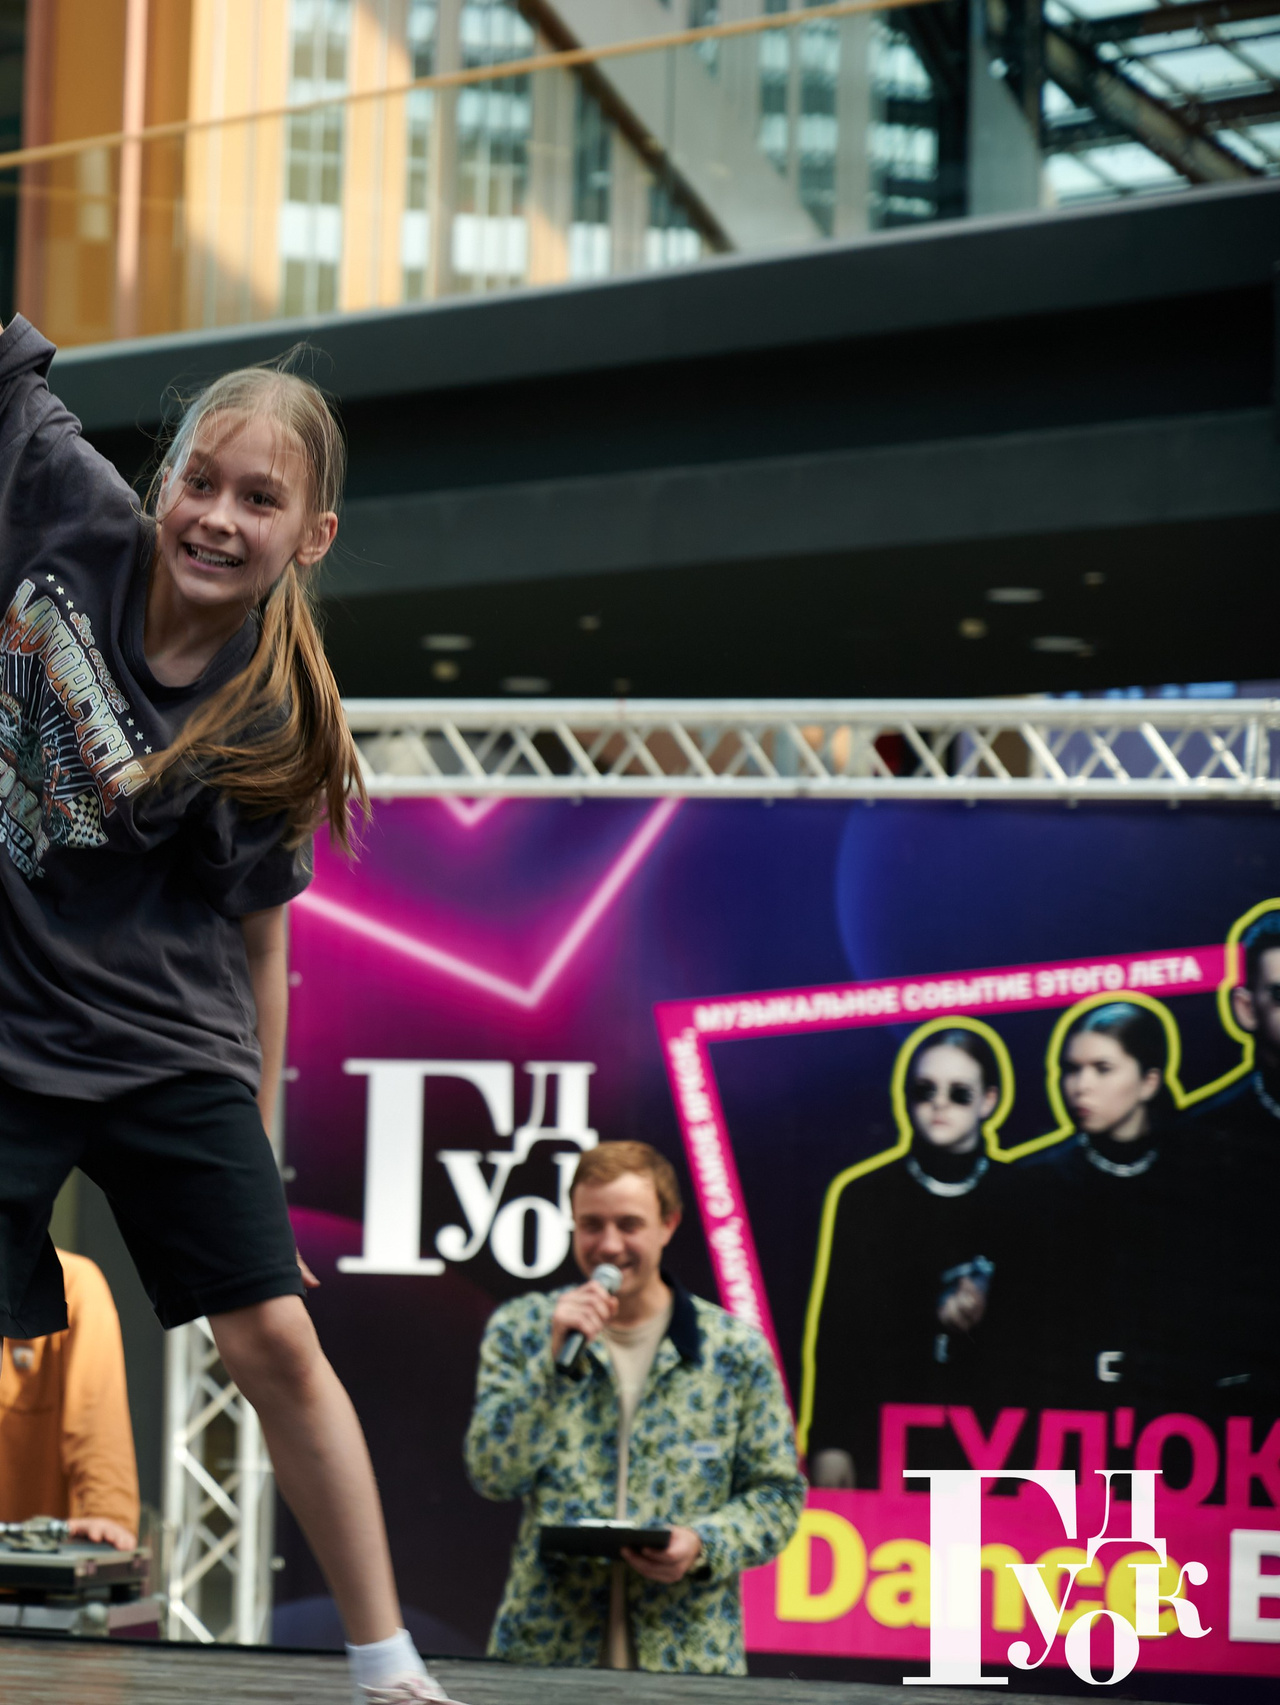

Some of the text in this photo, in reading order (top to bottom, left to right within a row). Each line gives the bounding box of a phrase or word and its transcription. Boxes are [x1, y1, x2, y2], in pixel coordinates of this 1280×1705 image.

[693, 956, 1202, 1033] МУЗЫКАЛЬНОЕ СОБЫТИЕ ЭТОГО ЛЕТА
[688, 1121, 735, 1219] САМОЕ
[775, 1508, 1186, 1639] Dance
